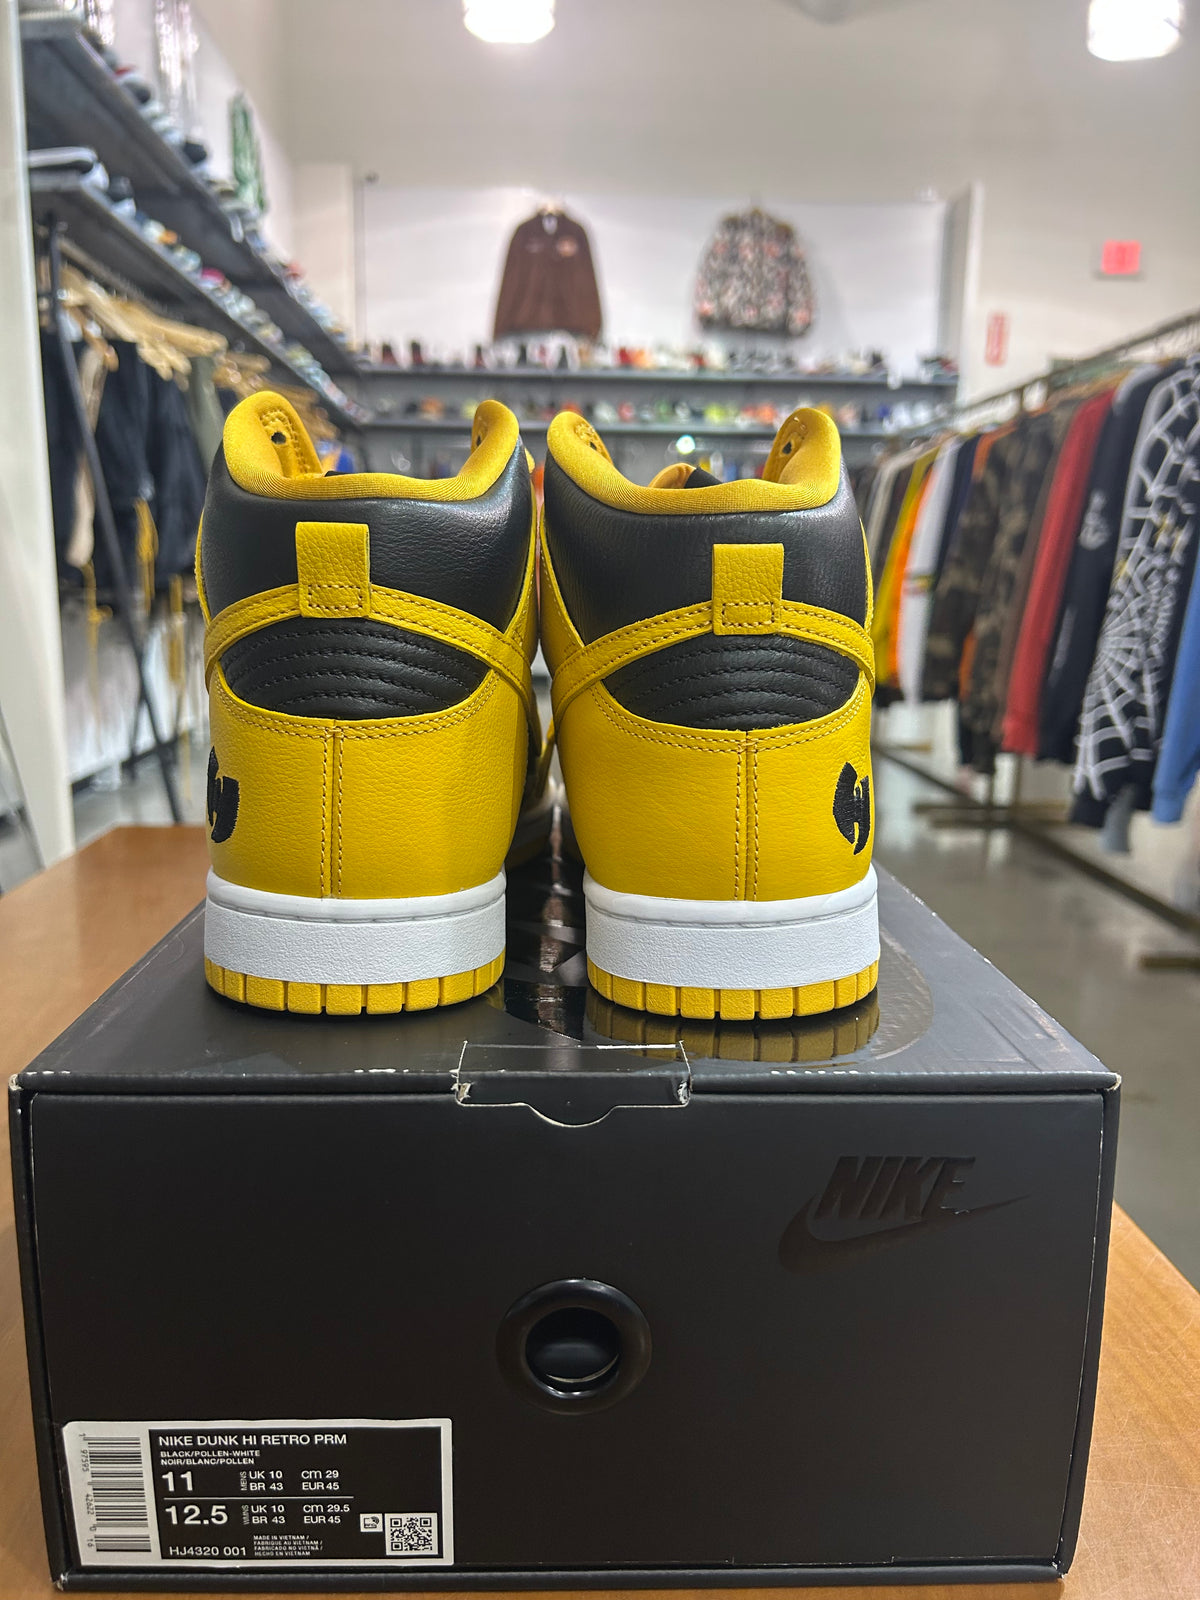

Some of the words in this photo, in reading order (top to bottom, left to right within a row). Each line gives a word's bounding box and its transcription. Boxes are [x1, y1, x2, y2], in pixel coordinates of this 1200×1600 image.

[814, 1155, 976, 1220] NIKE
[158, 1435, 193, 1446] NIKE
[197, 1435, 239, 1446] DUNK
[242, 1434, 257, 1445] HI
[261, 1434, 310, 1445] RETRO
[314, 1434, 347, 1445] PRM
[160, 1450, 260, 1458] BLACK/POLLEN-WHITE
[80, 1449, 89, 1472] 97595
[249, 1470, 265, 1479] UK
[269, 1470, 283, 1479] 10
[301, 1471, 322, 1480] cm
[325, 1470, 339, 1479] 29
[161, 1471, 194, 1492] 11
[250, 1482, 266, 1491] BR
[269, 1482, 284, 1491] 43
[302, 1482, 324, 1491] EUR
[326, 1482, 340, 1490] 45
[251, 1504, 267, 1513] UK
[271, 1504, 285, 1513] 10
[303, 1505, 324, 1513] cm
[327, 1504, 351, 1513] 29.5
[165, 1505, 229, 1525] 12.5
[252, 1515, 268, 1524] BR
[272, 1515, 286, 1524] 43
[303, 1516, 326, 1524] EUR
[327, 1516, 341, 1524] 45
[169, 1546, 219, 1556] HJ4320
[223, 1546, 247, 1556] 001
